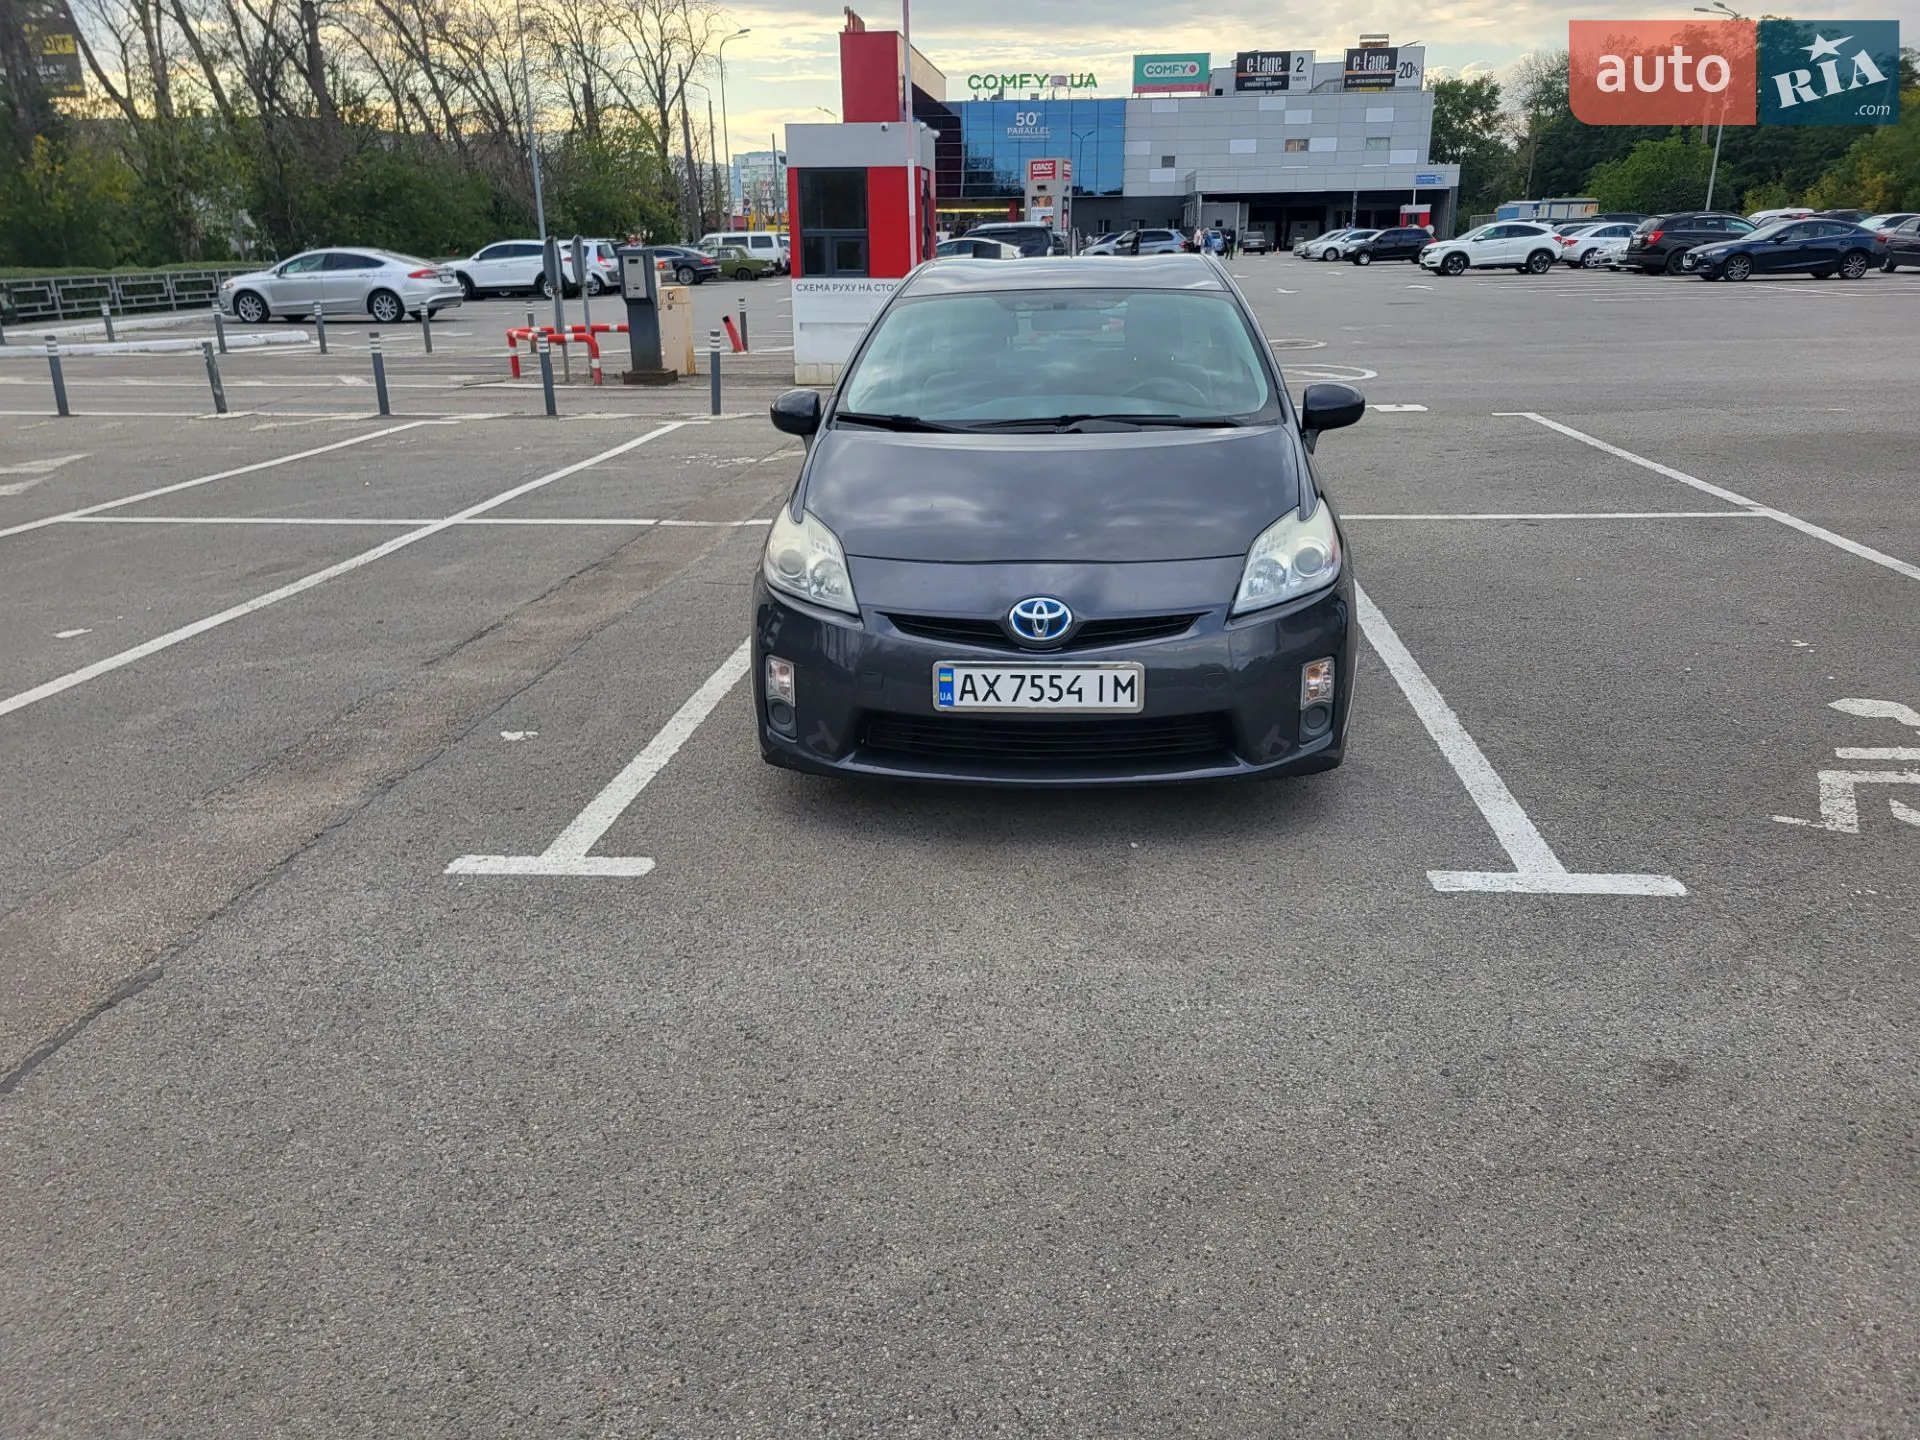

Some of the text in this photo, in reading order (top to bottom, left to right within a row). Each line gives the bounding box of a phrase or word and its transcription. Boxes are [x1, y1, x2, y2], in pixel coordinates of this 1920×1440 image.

[1146, 64, 1189, 75] COMFY
[1246, 54, 1282, 74] e-tage
[1296, 56, 1305, 73] 2
[1352, 51, 1389, 72] e-tage
[1396, 61, 1420, 79] -20%
[967, 74, 1049, 90] COMFY
[1007, 127, 1050, 135] PARALLEL
[796, 283, 899, 292] СХЕМА РУХУ НА СТО
[940, 691, 953, 701] UA
[959, 674, 1136, 703] AX 7554 IM
